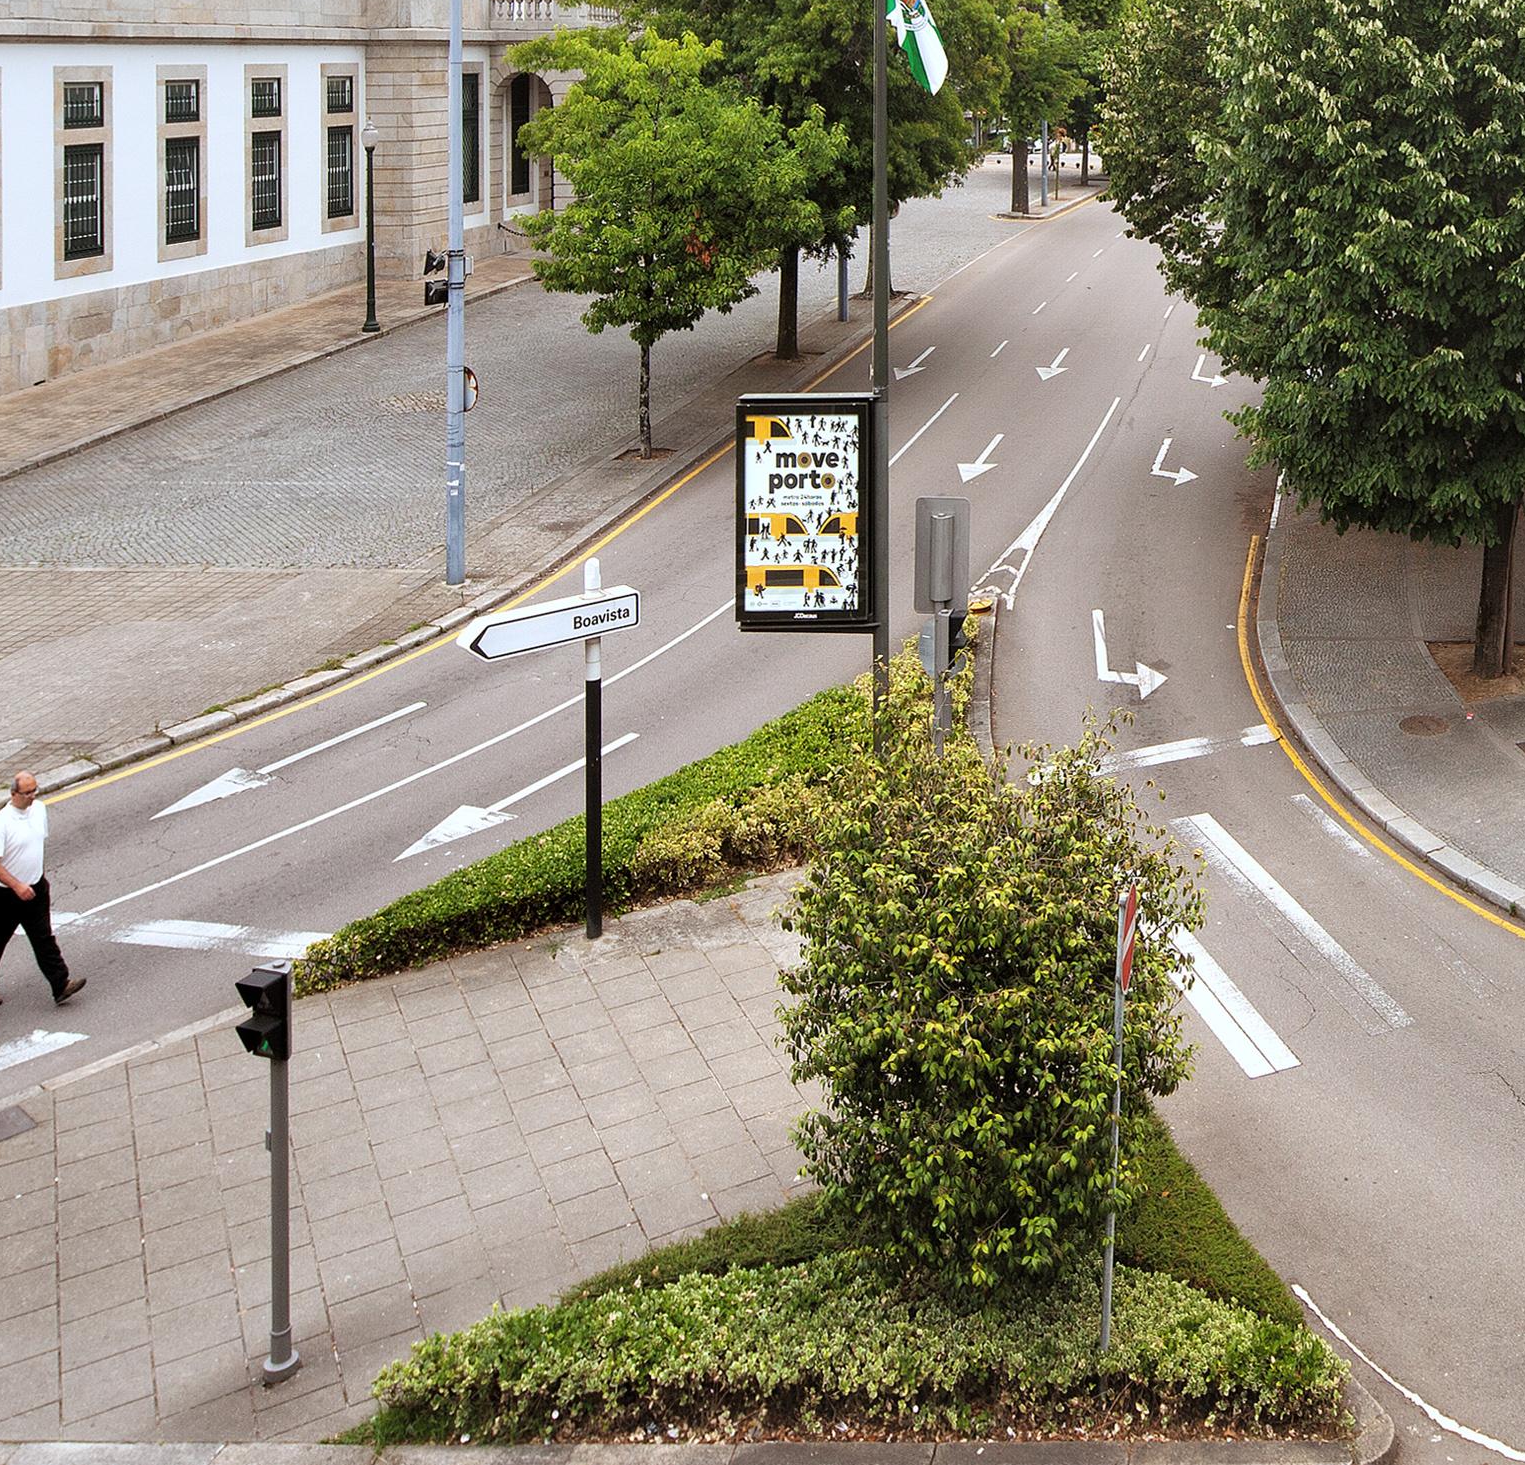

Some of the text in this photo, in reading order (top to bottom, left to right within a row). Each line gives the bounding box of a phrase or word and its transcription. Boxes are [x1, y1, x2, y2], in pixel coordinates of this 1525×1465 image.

[775, 451, 839, 468] move
[769, 470, 836, 494] porto
[573, 607, 630, 630] Boavista
